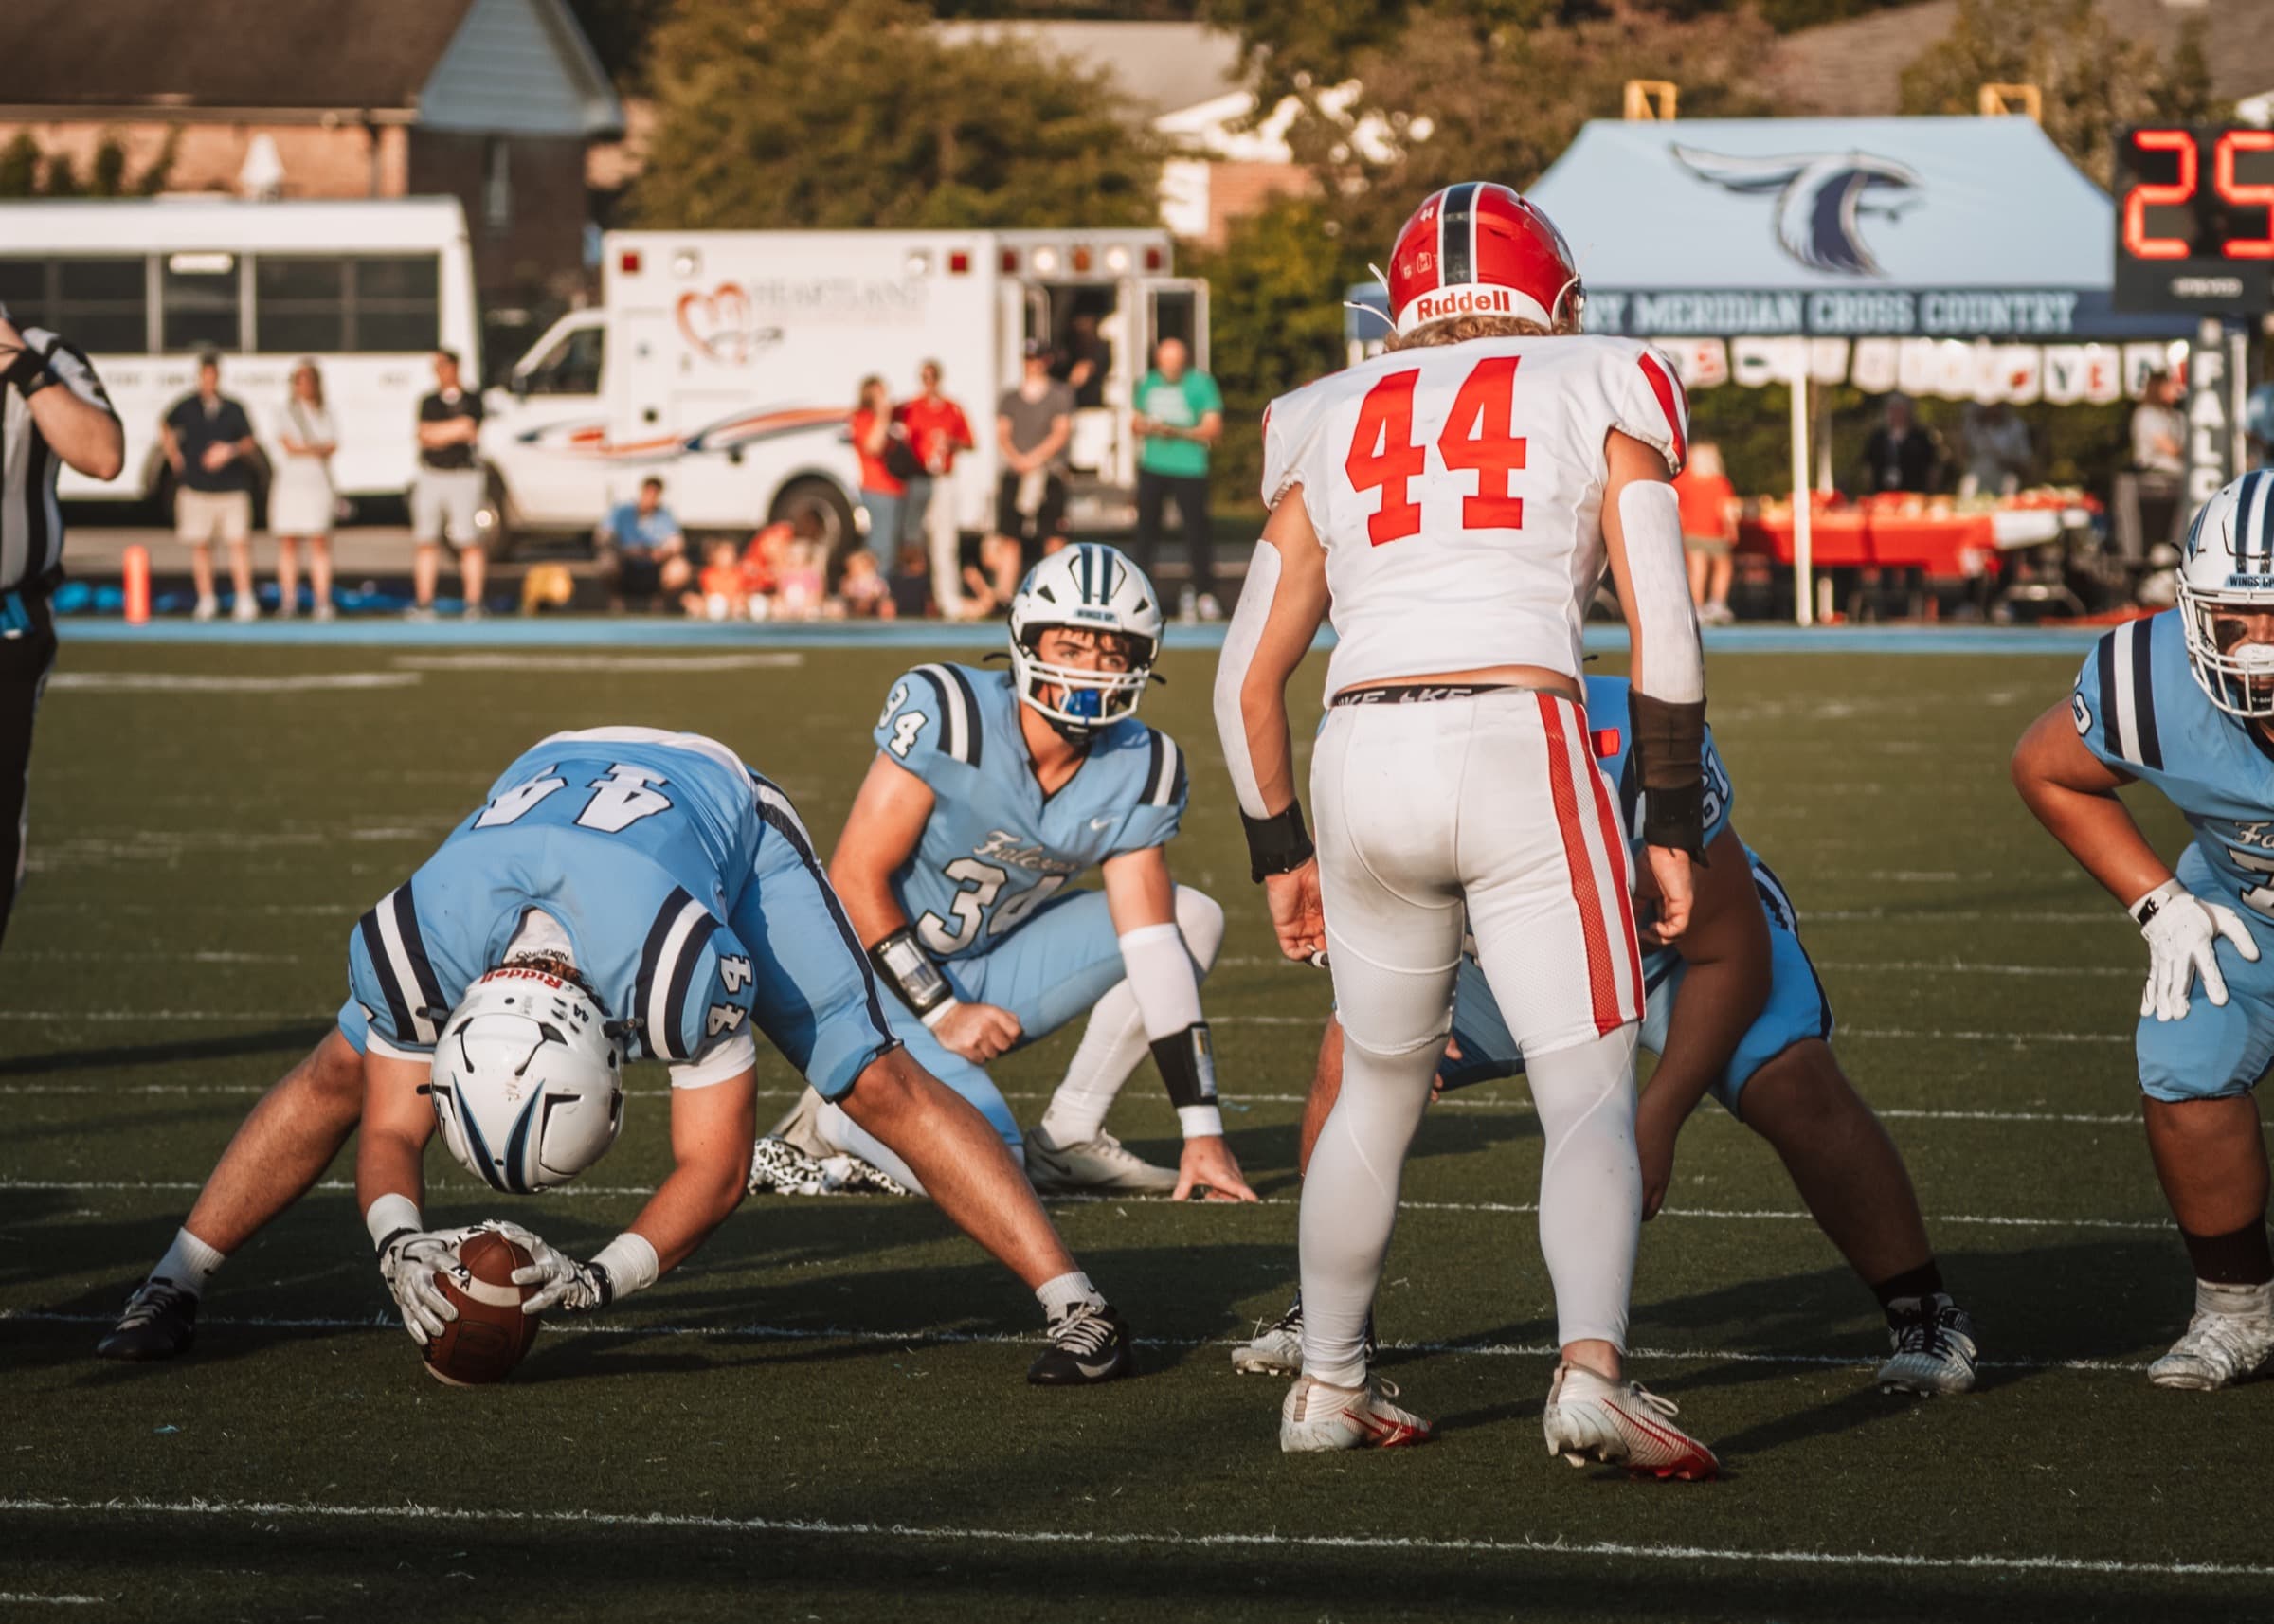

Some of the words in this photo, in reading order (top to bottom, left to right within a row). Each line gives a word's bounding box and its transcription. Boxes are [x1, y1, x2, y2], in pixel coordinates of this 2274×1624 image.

[1420, 206, 1435, 222] 44
[2123, 129, 2274, 260] 25
[1417, 290, 1510, 323] Riddell
[1632, 292, 1799, 332] MERIDIAN
[1807, 292, 1915, 333] CROSS
[1920, 292, 2078, 333] COUNTRY
[1345, 355, 1527, 548] 44
[2190, 351, 2225, 516] FALC
[2229, 575, 2260, 586] WINGS
[472, 761, 674, 834] 44
[915, 857, 1071, 957] 34
[479, 967, 564, 990] Riddell
[706, 953, 753, 1039] 44
[573, 1003, 589, 1023] 44
